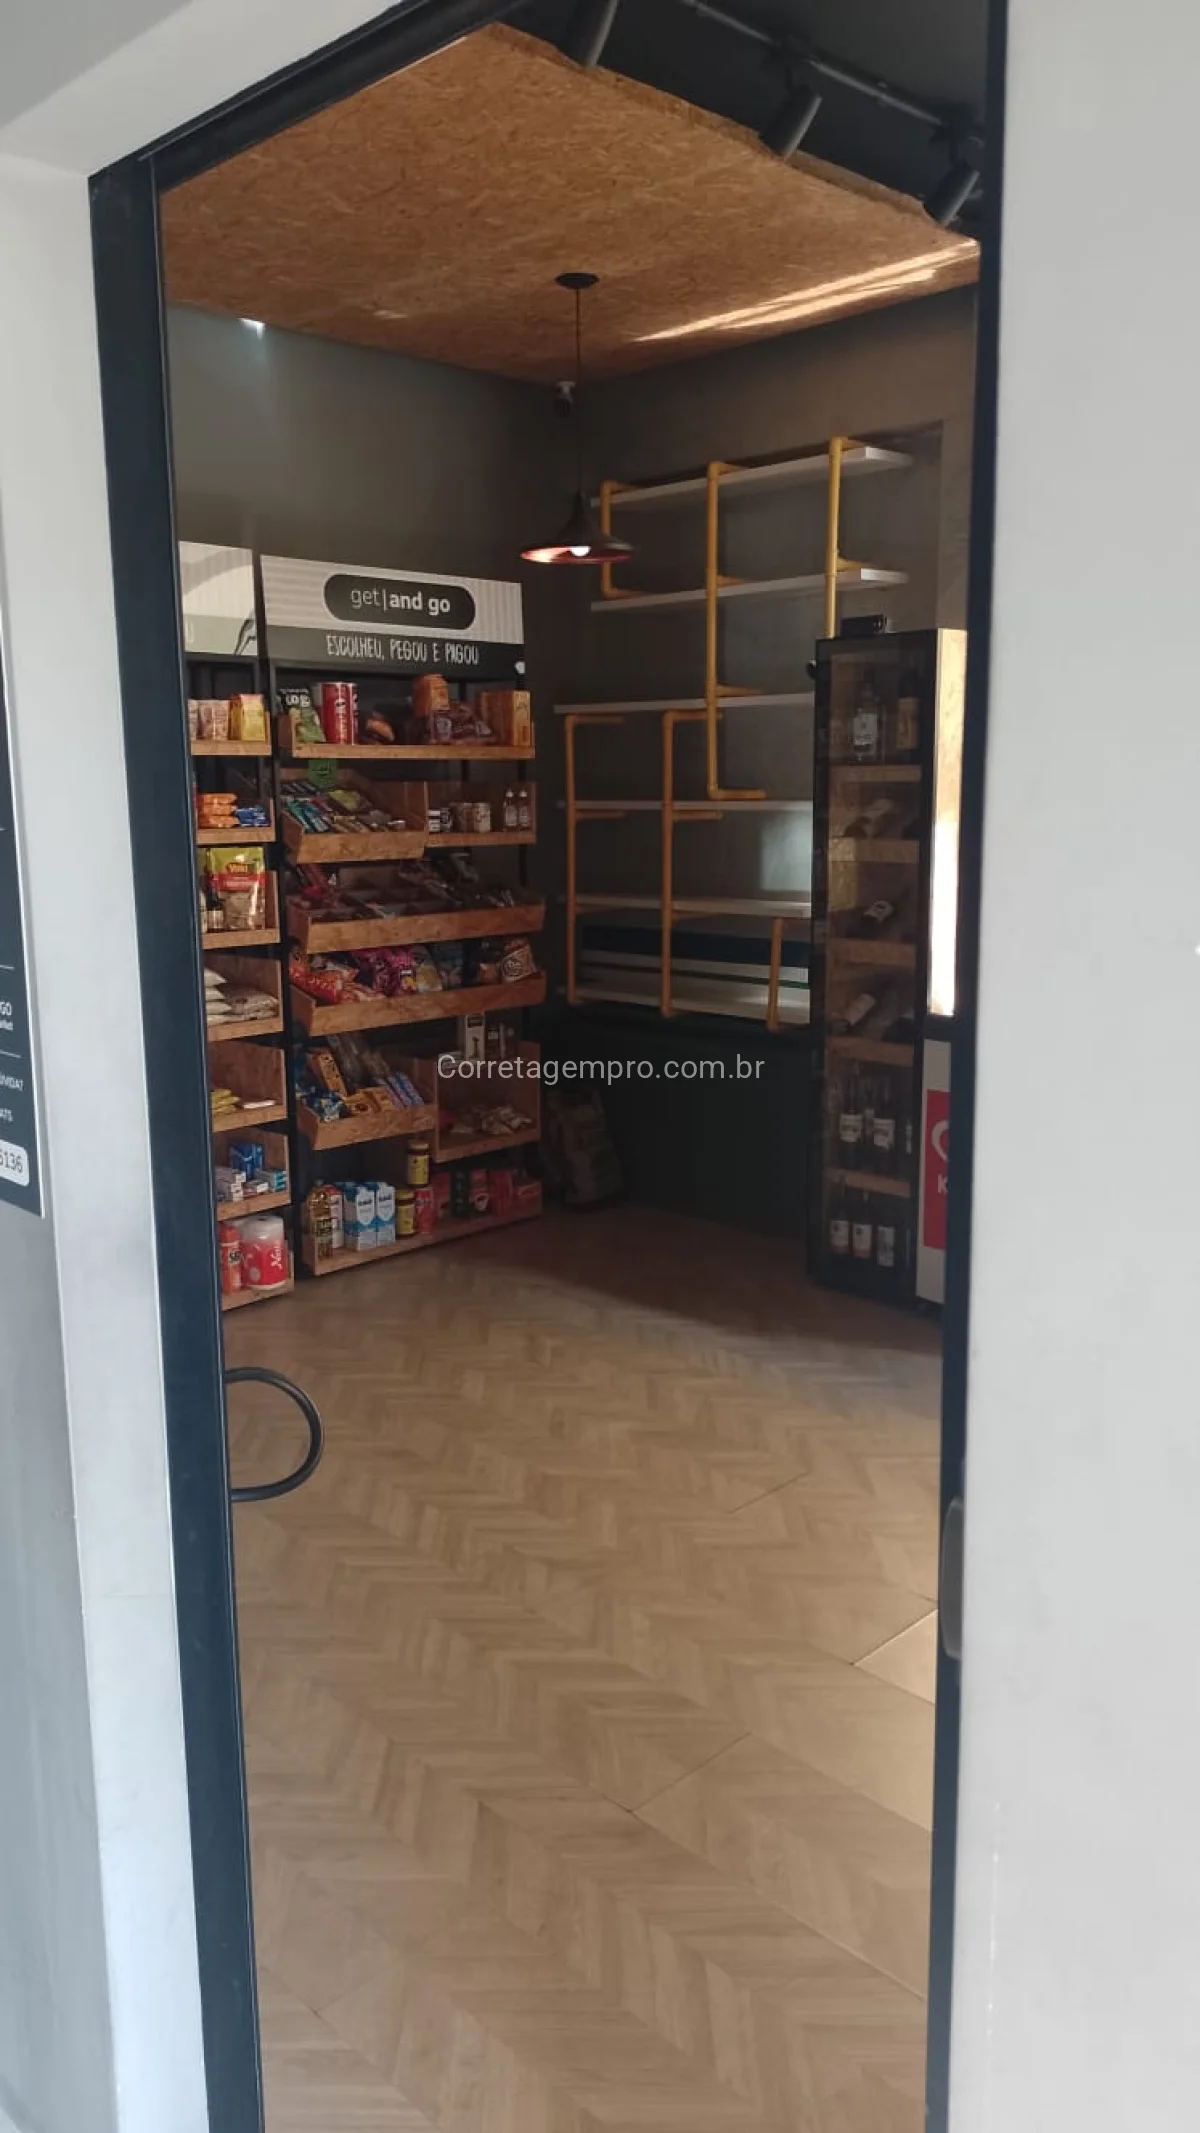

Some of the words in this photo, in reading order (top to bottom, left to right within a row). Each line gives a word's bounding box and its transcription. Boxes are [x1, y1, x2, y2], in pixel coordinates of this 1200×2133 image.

[428, 599, 450, 616] go
[326, 634, 386, 662] ESCOLHEU,
[389, 637, 428, 662] PEGOU
[433, 642, 441, 663] E
[444, 643, 480, 666] PAGOU
